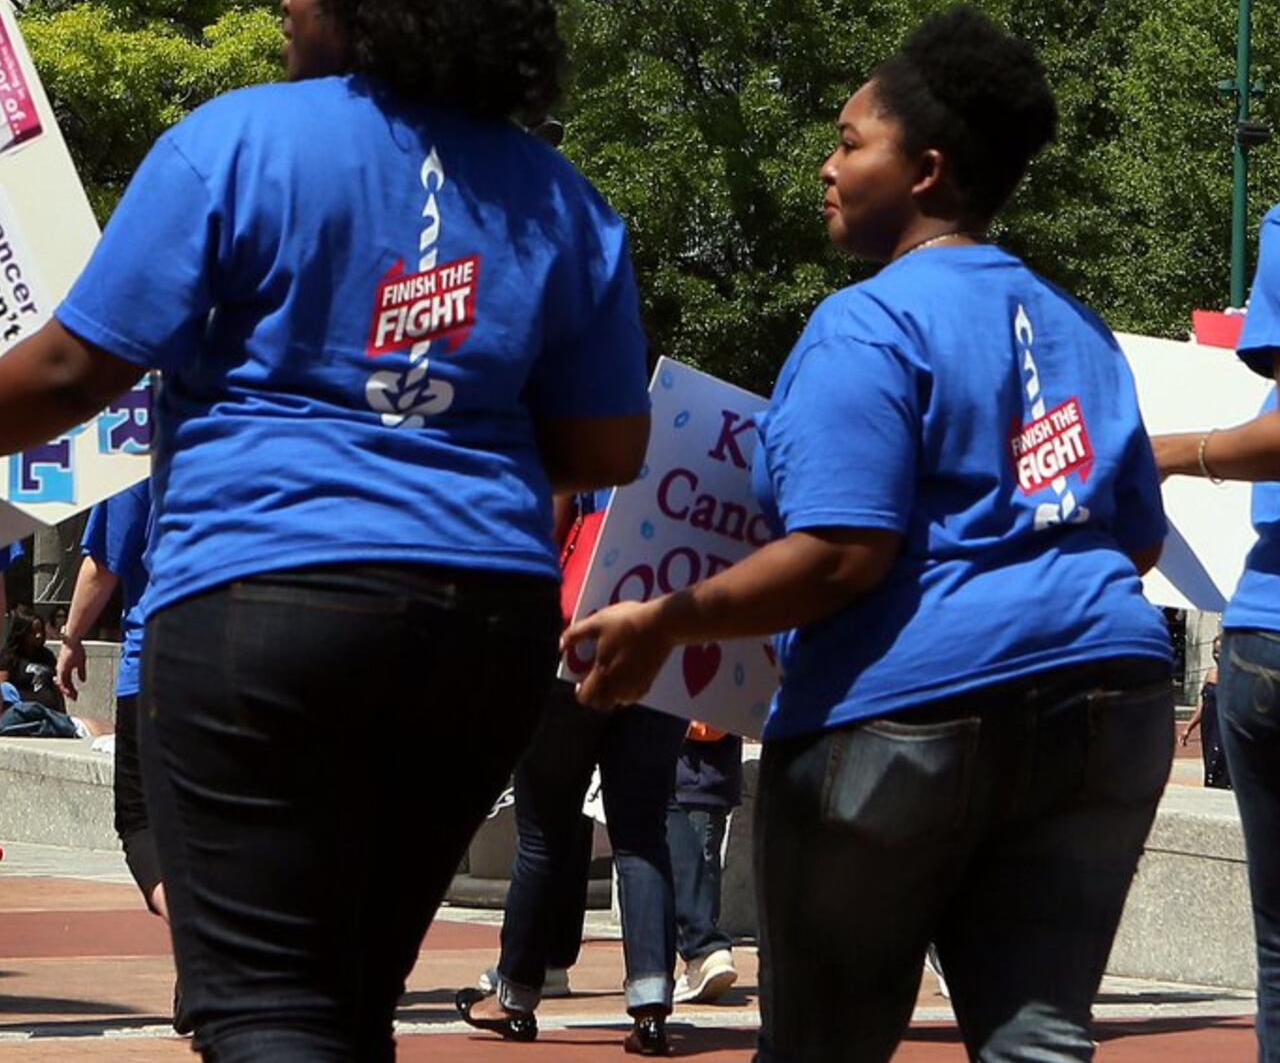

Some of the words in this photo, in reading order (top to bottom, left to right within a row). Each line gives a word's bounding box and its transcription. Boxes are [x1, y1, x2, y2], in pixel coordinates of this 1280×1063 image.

[382, 274, 436, 308] FINISH
[440, 261, 475, 288] THE
[374, 286, 472, 348] FIGHT
[1011, 418, 1054, 457] FINISH
[1049, 402, 1080, 431] THE
[1017, 423, 1086, 489] FIGHT
[656, 468, 776, 549] Canc
